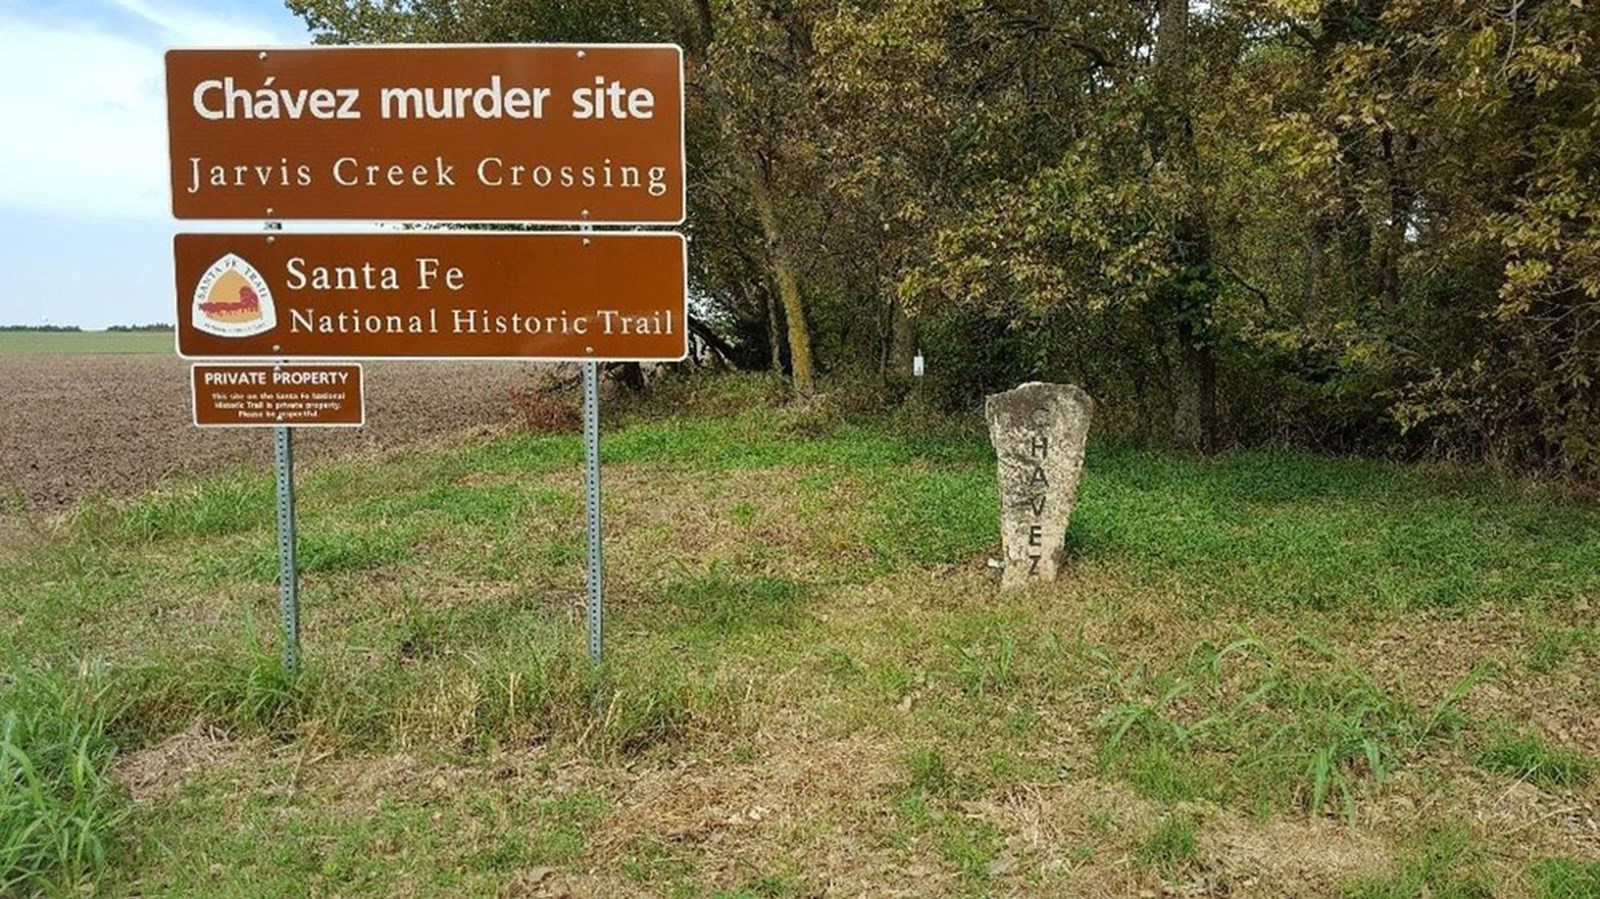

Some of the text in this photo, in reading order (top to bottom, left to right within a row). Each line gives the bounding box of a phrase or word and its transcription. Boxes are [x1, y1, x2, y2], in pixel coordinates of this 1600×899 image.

[193, 76, 654, 120] Chávez murder site
[188, 156, 667, 196] Jarvis Creek Crossing
[286, 257, 465, 290] Santa Fe
[289, 308, 438, 335] National
[452, 308, 588, 335] Historic
[595, 308, 674, 335] Trail
[204, 371, 349, 385] PRIVATE PROPERTY
[246, 401, 264, 410] Trail
[275, 401, 303, 411] private
[275, 392, 299, 400] Santa
[1028, 407, 1051, 576] CHAVEZ
